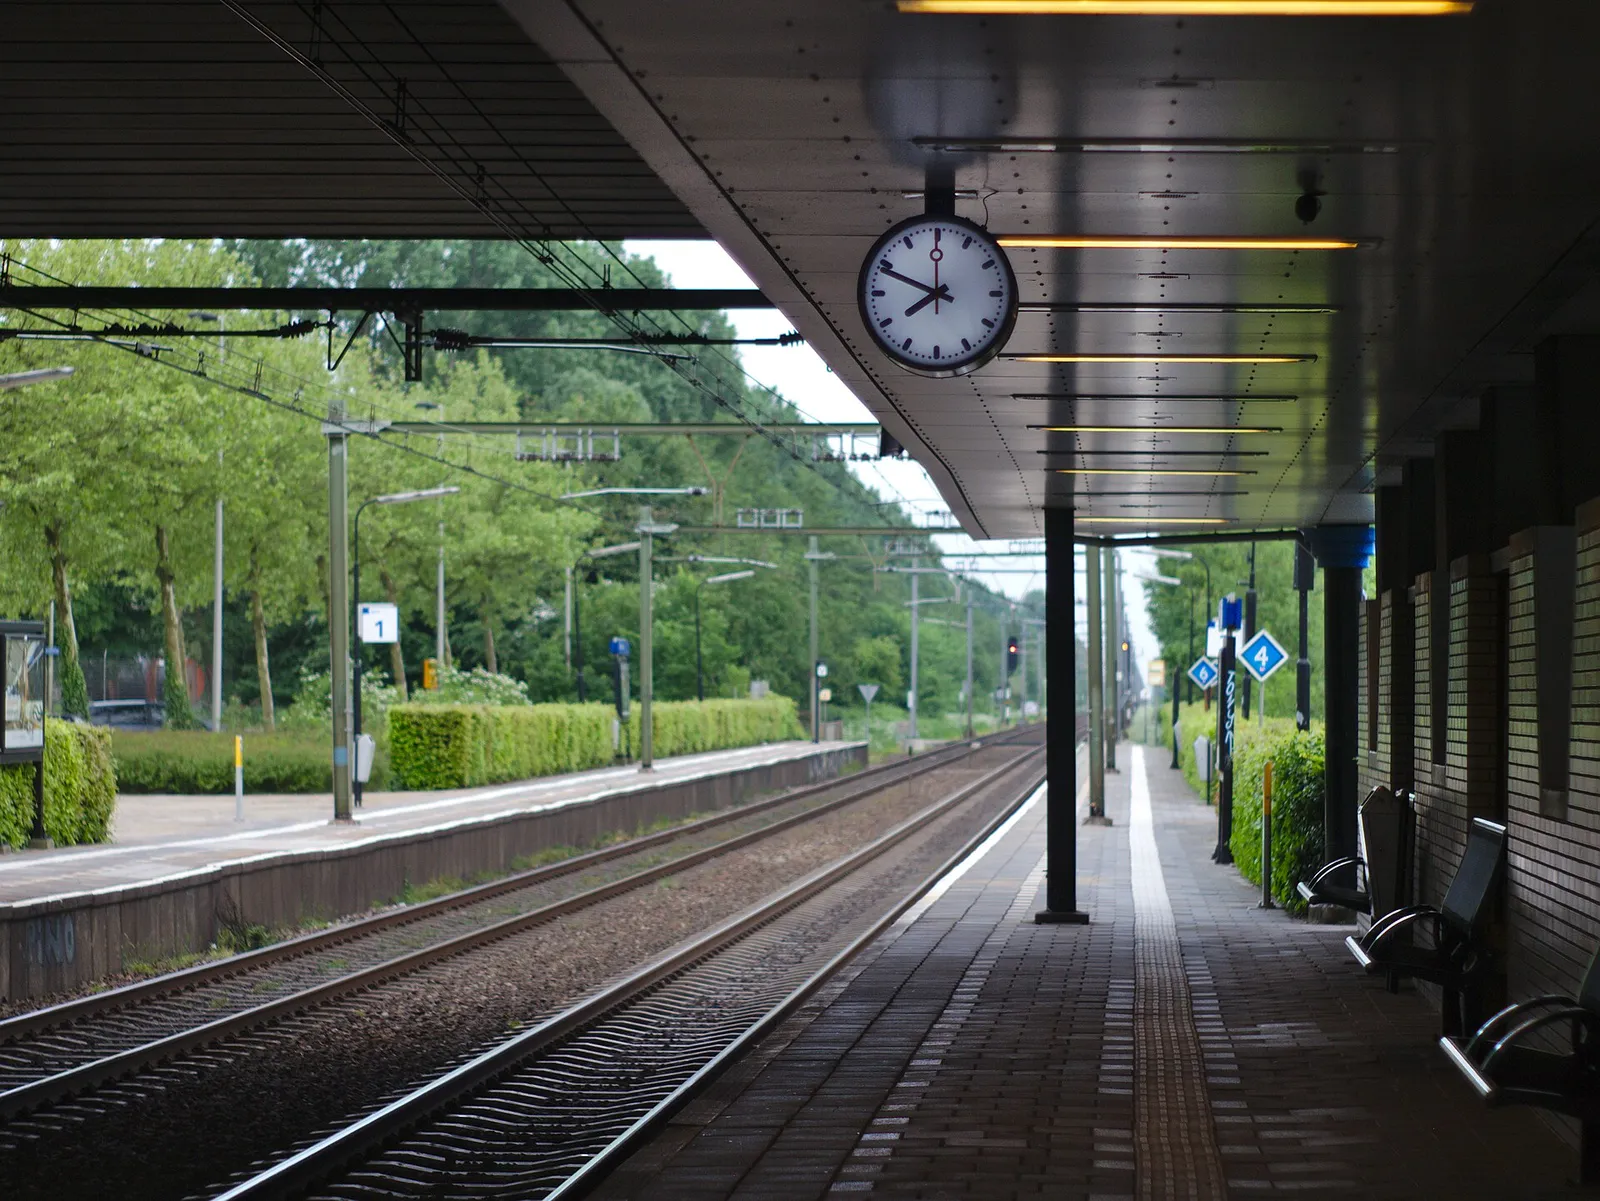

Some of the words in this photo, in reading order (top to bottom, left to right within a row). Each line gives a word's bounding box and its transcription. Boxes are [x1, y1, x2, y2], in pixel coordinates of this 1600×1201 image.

[374, 619, 384, 638] 1
[1254, 645, 1269, 668] 4
[1199, 665, 1209, 680] 6
